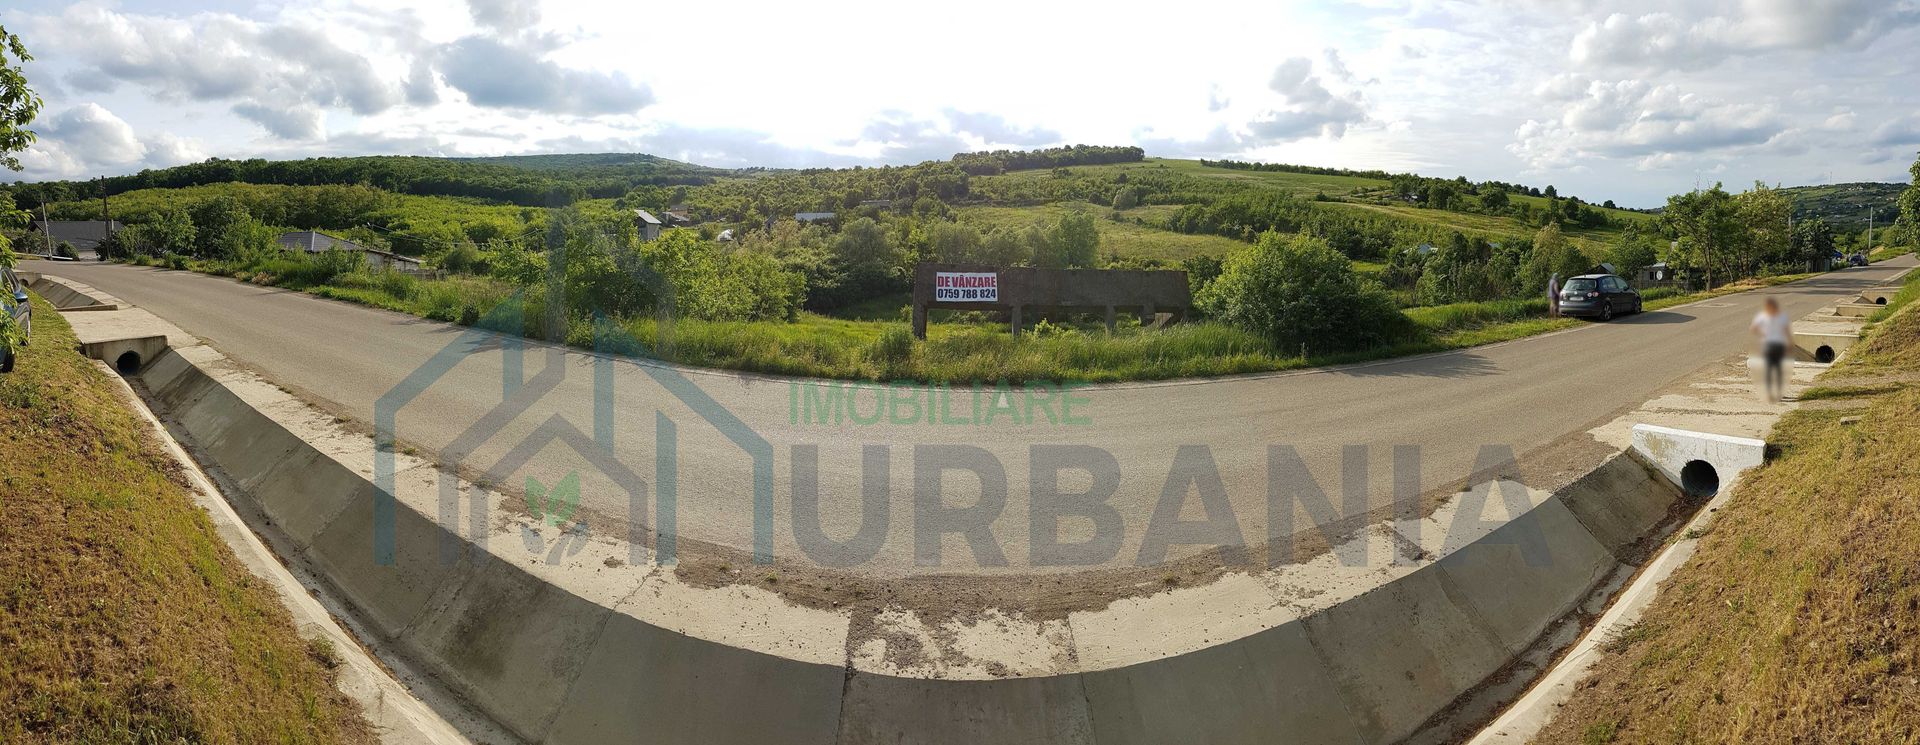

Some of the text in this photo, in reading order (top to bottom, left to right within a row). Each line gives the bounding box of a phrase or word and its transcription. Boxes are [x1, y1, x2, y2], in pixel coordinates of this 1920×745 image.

[938, 275, 996, 287] DE VÂNZARE
[938, 289, 996, 298] 0759 788 824
